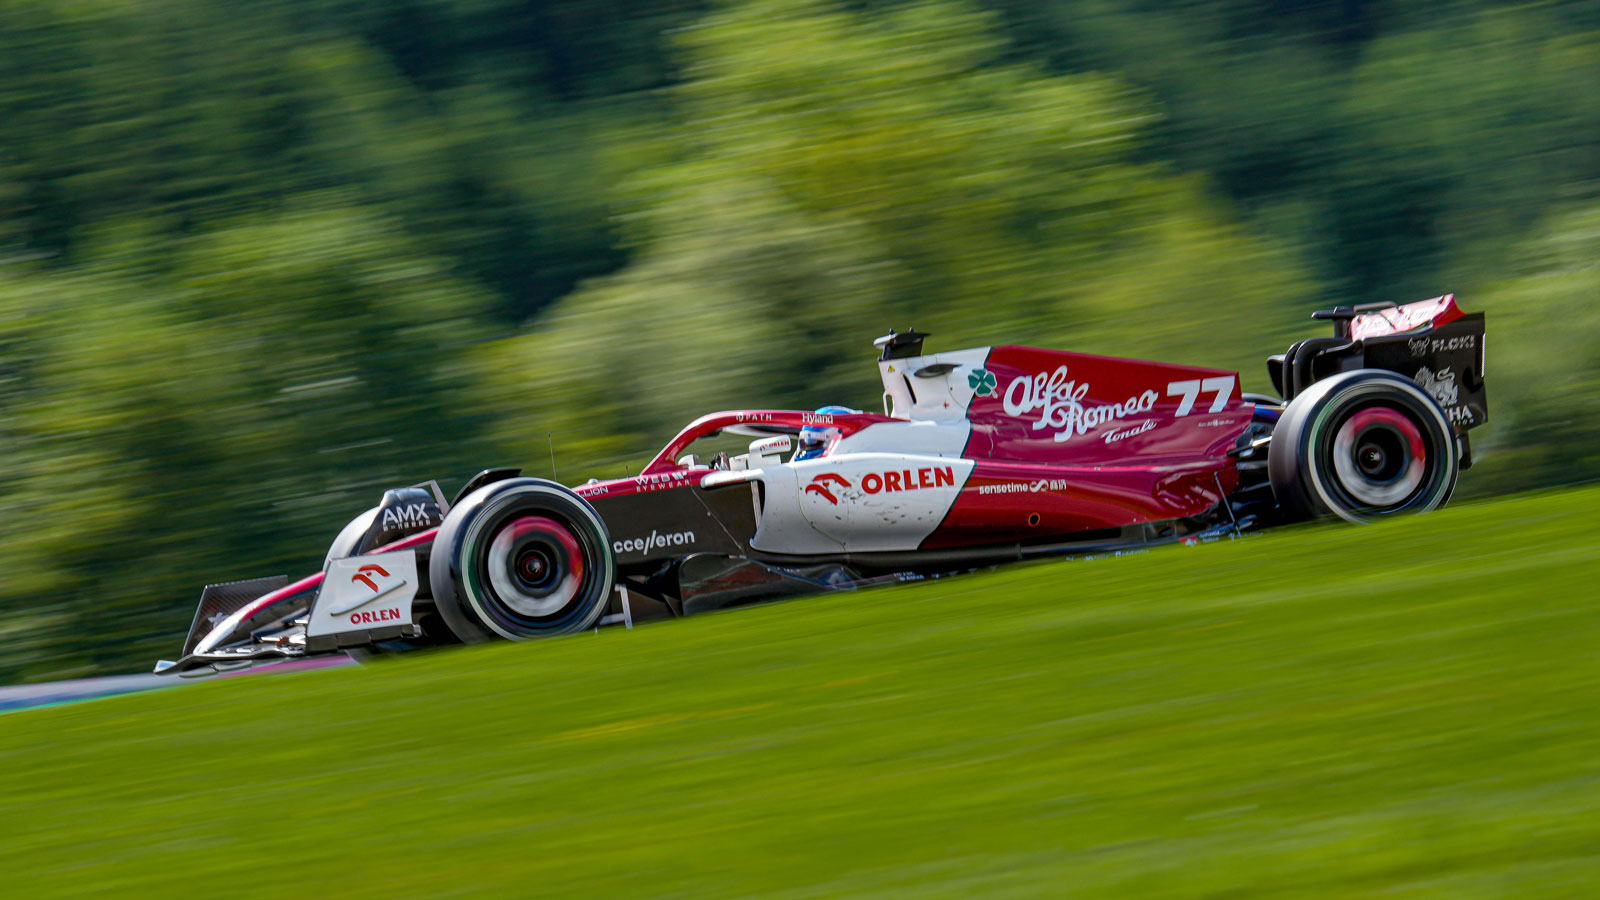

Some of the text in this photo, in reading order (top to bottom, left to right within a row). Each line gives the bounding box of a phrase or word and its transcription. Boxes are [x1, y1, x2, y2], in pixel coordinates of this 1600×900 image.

[1431, 335, 1475, 353] FLOKI
[1003, 365, 1089, 430] Alfa
[1167, 375, 1236, 417] 77
[802, 412, 834, 425] Hyland
[1047, 389, 1159, 443] Romeo
[1100, 419, 1158, 444] Tonale
[635, 473, 671, 485] WEB
[636, 479, 690, 492] EYEWEAR
[861, 466, 955, 494] ORLEN
[979, 482, 1028, 495] sensetime
[382, 502, 430, 525] AMX
[350, 607, 401, 625] ORLEN
